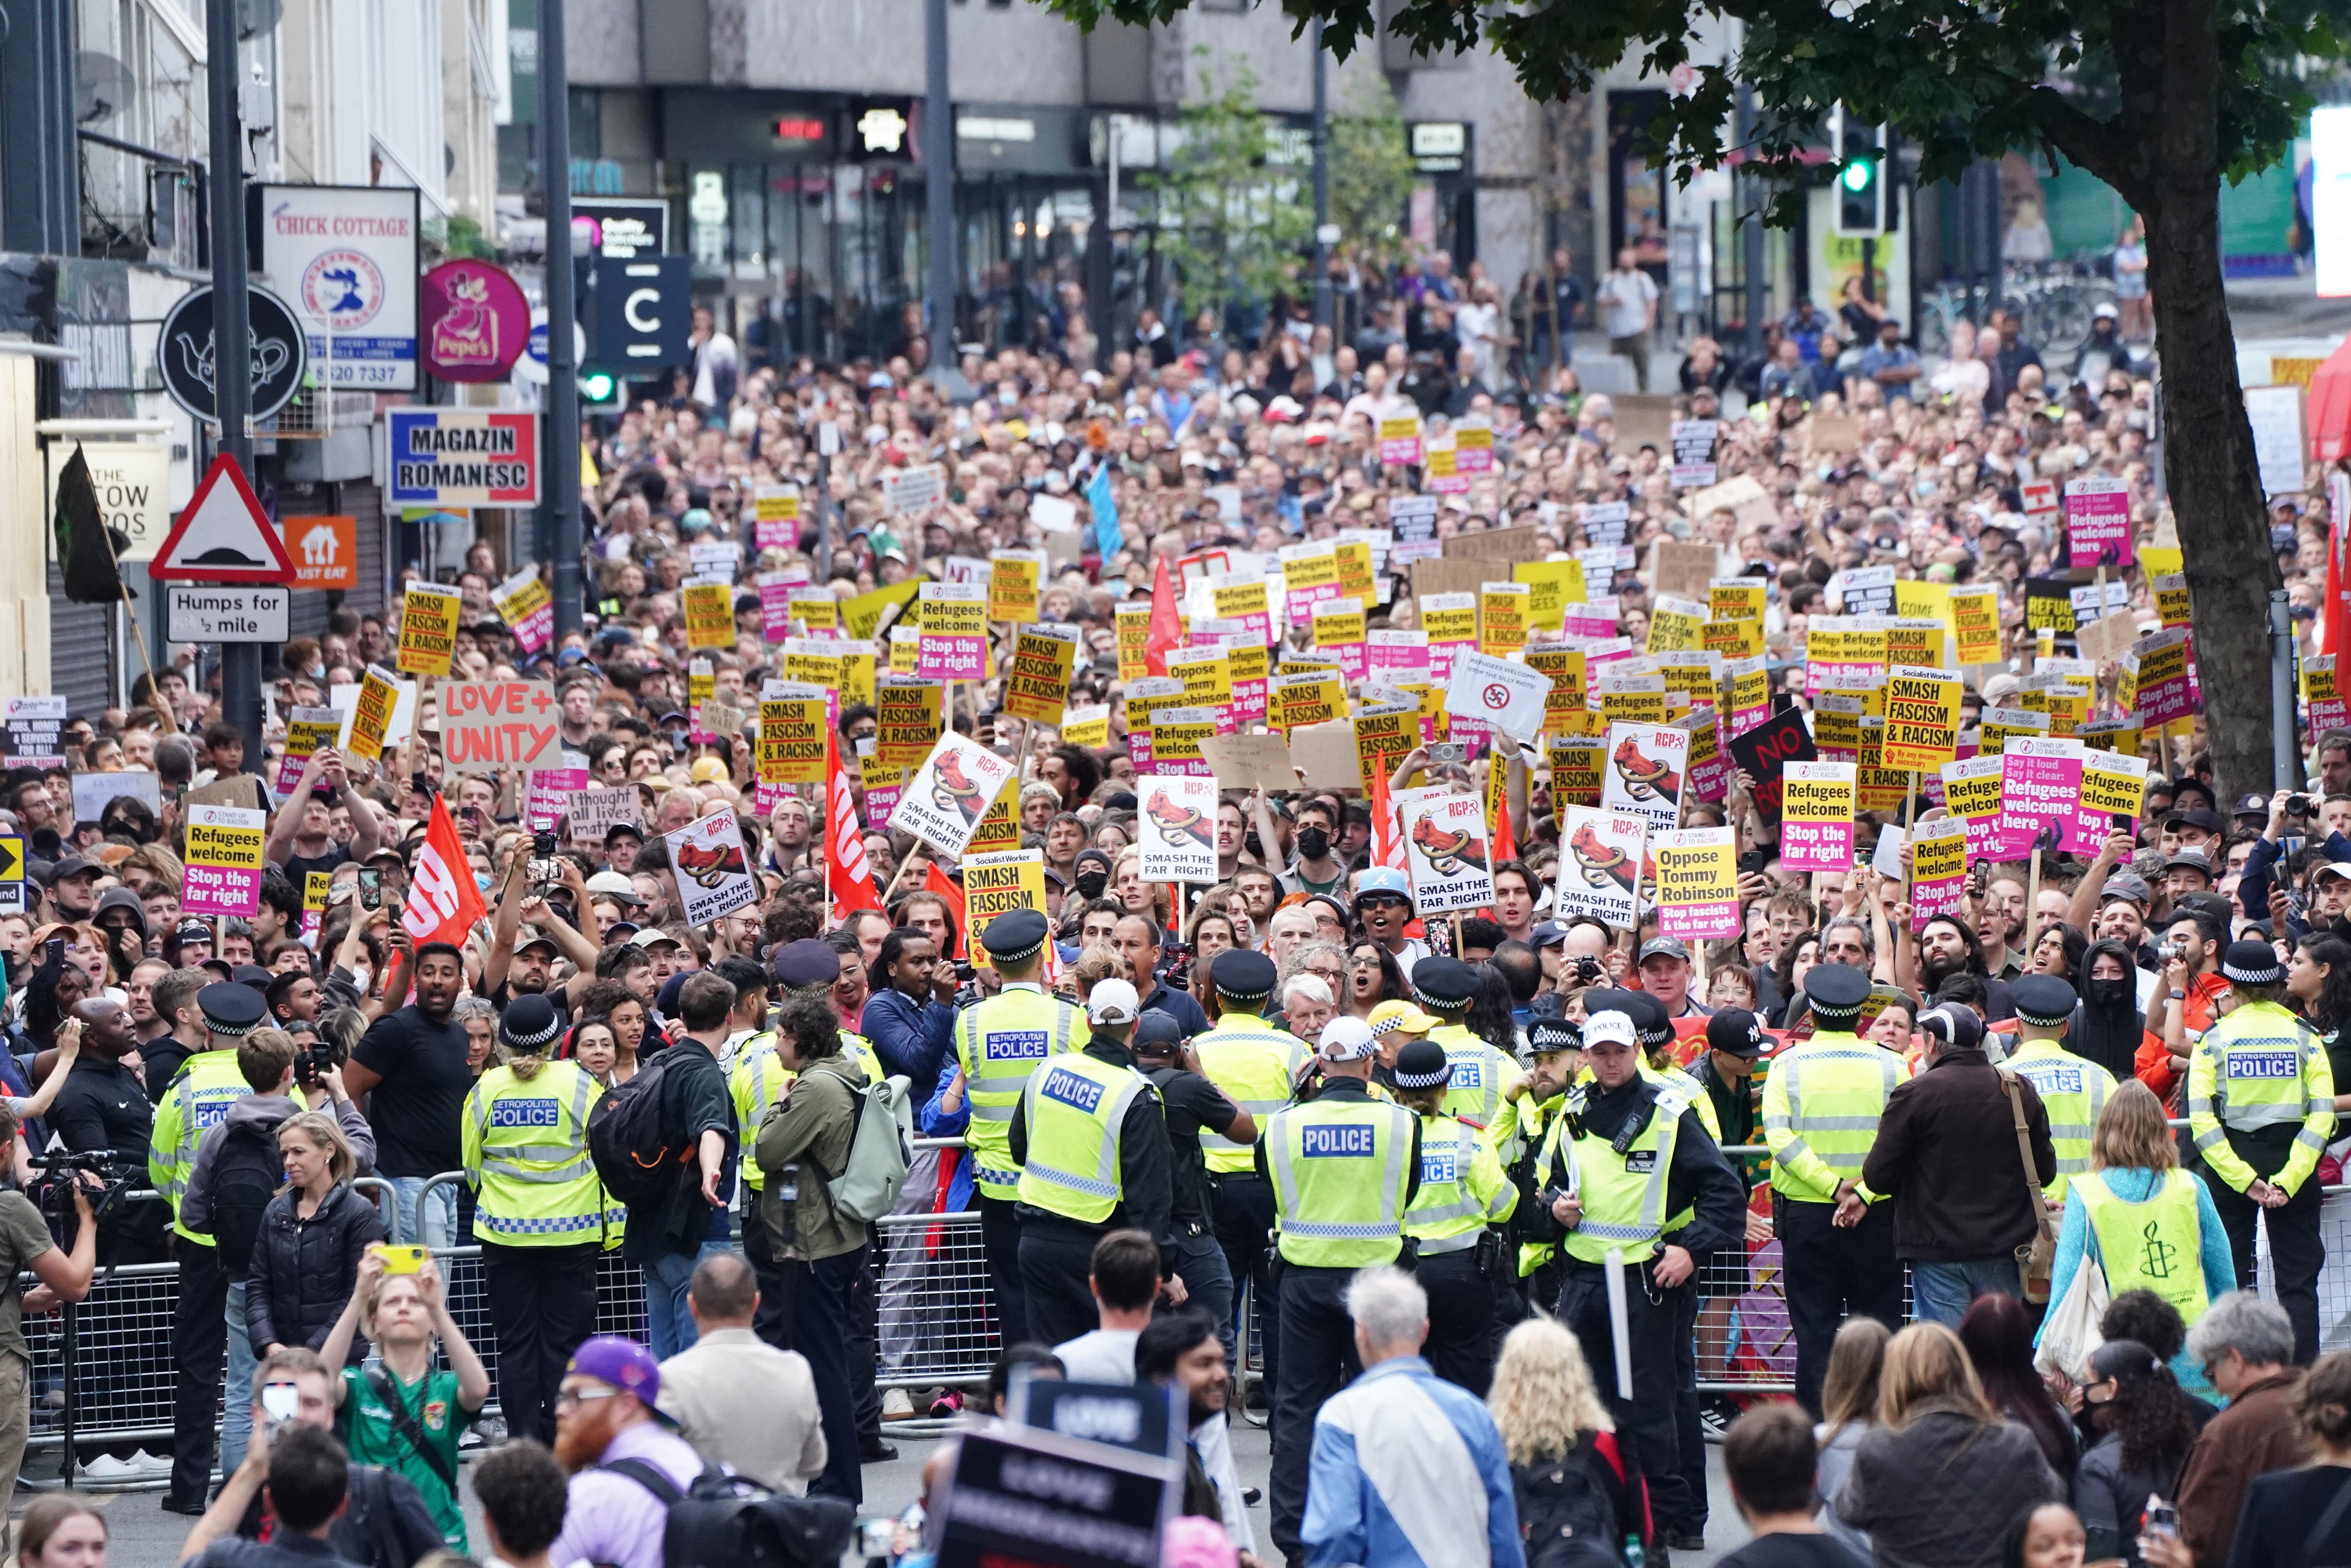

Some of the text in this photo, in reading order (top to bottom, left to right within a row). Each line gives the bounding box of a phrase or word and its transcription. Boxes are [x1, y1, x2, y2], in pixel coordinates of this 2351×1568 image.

[276, 216, 408, 237] CHICK COTTAGE
[360, 367, 396, 382] 7337
[411, 427, 514, 453] MAGAZIN
[93, 470, 124, 482] THE
[398, 463, 526, 488] ROMANESC
[2070, 514, 2127, 528] Refugees
[2071, 527, 2125, 539] welcome
[2072, 541, 2100, 553] here
[296, 566, 347, 580] UST EAT
[177, 595, 278, 612] Humps for
[408, 594, 443, 611] SMASH
[923, 603, 983, 618] Refugees
[218, 619, 258, 633] mile
[405, 613, 448, 632] FASCISM
[923, 618, 980, 631] welcome
[402, 634, 450, 652] & RACISM
[922, 639, 978, 653] Stop the
[922, 655, 977, 671] far right
[1471, 659, 1538, 681] REFUGEES WELCOME!
[1468, 667, 1484, 676] STOP
[1499, 675, 1515, 684] SILLY
[1516, 680, 1536, 690] RIOTS!
[1902, 670, 1952, 681] Socialist Worker
[1892, 680, 1940, 701] SMASH
[446, 684, 553, 716] LOVE +
[2310, 700, 2346, 716] Black
[763, 704, 805, 719] SMASH
[1889, 703, 1949, 724] FASCISM
[764, 724, 815, 738] FASCISM
[2312, 716, 2345, 730] Lives
[446, 723, 557, 765] UNITY
[1886, 725, 1954, 747] & RACISM
[19, 744, 34, 755] FOR
[764, 744, 823, 759] & RACISM
[1755, 726, 1800, 770] NO
[1905, 751, 1915, 759] any
[976, 755, 997, 772] RCP
[1896, 759, 1926, 768] necessary
[2007, 756, 2058, 769] Say it loud
[2006, 768, 2064, 781] Say it clear:
[1185, 781, 1203, 795] RCP
[1787, 784, 1850, 801] Refugees
[2005, 779, 2077, 800] Refugees
[577, 788, 631, 811] thought
[2004, 798, 2073, 815] welcome
[572, 806, 630, 821] all lives
[1449, 801, 1469, 818] RCP
[1787, 802, 1848, 816] welcome
[707, 819, 724, 837] RCP
[905, 802, 967, 841] SMASH THE
[1612, 819, 1632, 834] RCP
[2003, 812, 2039, 830] here
[191, 829, 259, 849] Refugees
[899, 812, 961, 852] FAR RIGHT!
[1785, 824, 1846, 842] Stop the
[191, 846, 255, 862] welcome
[1785, 845, 1845, 862] far right
[1918, 840, 1964, 858] Refugees
[975, 854, 1030, 865] Socialist Worker
[1145, 854, 1213, 864] SMASH THE
[1660, 850, 1718, 868] Oppose
[1918, 856, 1962, 876] welcome
[188, 868, 251, 887] Stop the
[968, 867, 1019, 889] SMASH
[1145, 866, 1213, 876] FAR RIGHT!
[1661, 869, 1717, 885] Tommy
[1419, 879, 1489, 896] SMASH THE
[1662, 887, 1734, 902] Robinson
[1916, 879, 1961, 902] Stop the
[186, 888, 248, 906] far right
[689, 880, 750, 913] SMASH THE
[970, 891, 1033, 913] FASCISM
[1420, 891, 1491, 908] FAR RIGHT!
[1562, 892, 1632, 910] SMASH THE
[691, 891, 753, 923] FAR RIGHT!
[1561, 904, 1631, 922] FAR RIGHT!
[1662, 905, 1729, 920] Stop fascists
[1915, 903, 1934, 918] far
[1663, 917, 1736, 931] & the far right
[1594, 1022, 1622, 1033] POLICE
[990, 1033, 1044, 1042] METROPOLITAN
[990, 1041, 1045, 1057] POLICE
[2229, 1060, 2295, 1077] POLICE
[1045, 1072, 1101, 1109] POLICE
[493, 1100, 557, 1108] METROPOLITAN
[491, 1109, 556, 1126] POLICE
[1306, 1129, 1371, 1152] POLICE
